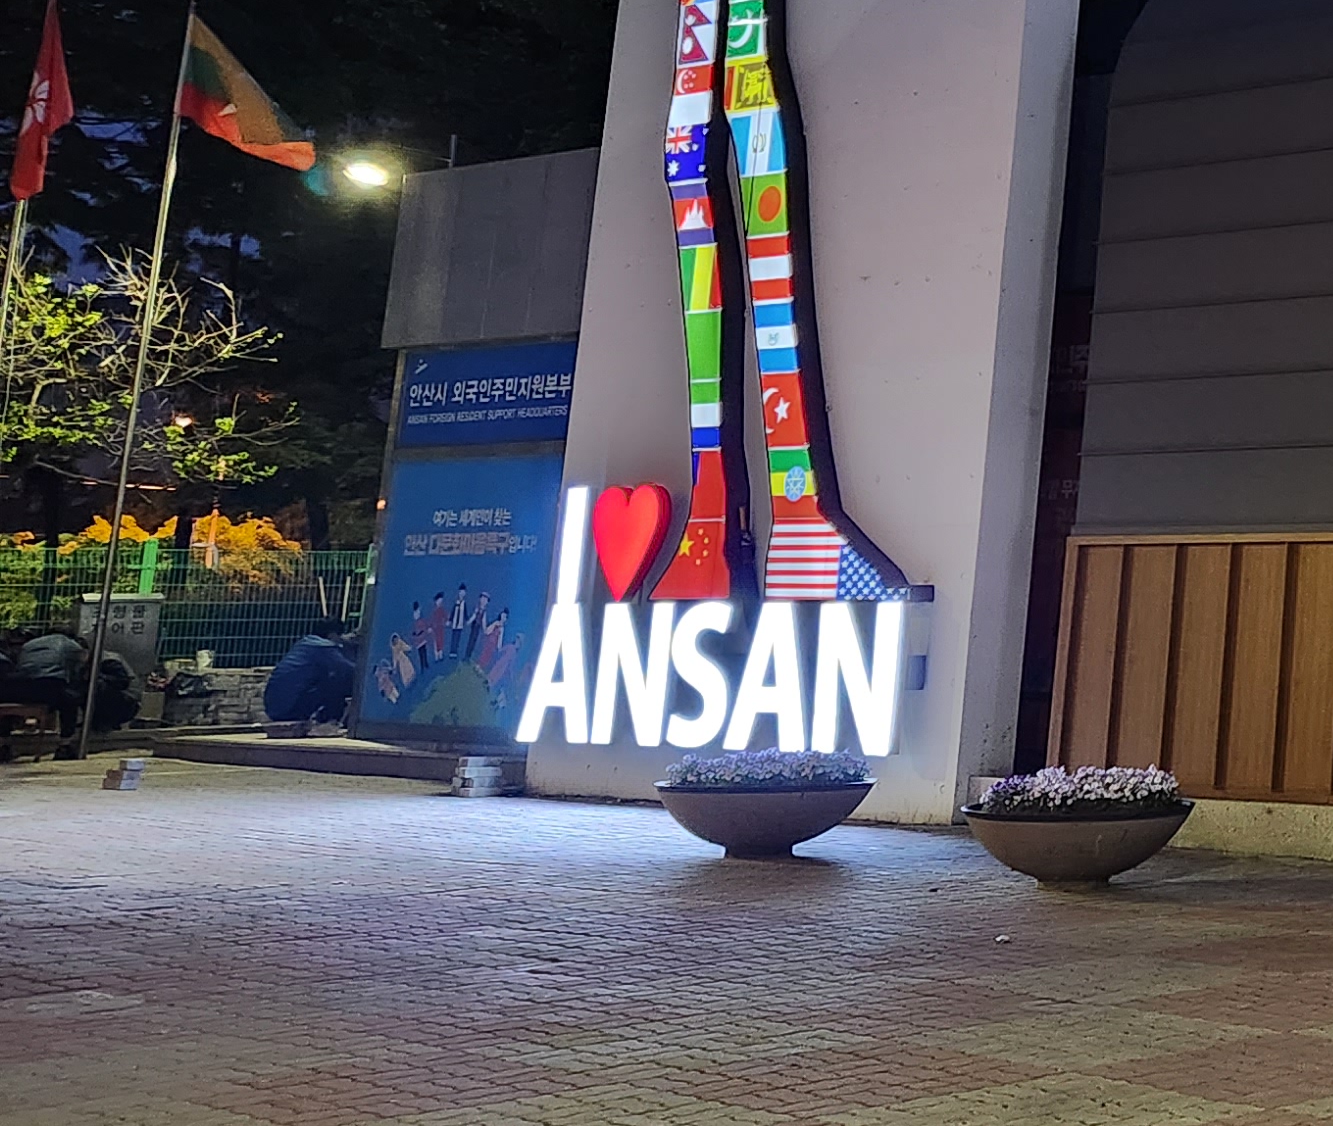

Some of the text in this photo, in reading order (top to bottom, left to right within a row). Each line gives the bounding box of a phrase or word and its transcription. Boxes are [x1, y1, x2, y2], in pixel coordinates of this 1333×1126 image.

[409, 373, 572, 408] 안산시 외국인주민지원본부
[487, 407, 517, 421] SUPPORT
[555, 485, 589, 604] I
[515, 600, 904, 758] ANSAN
